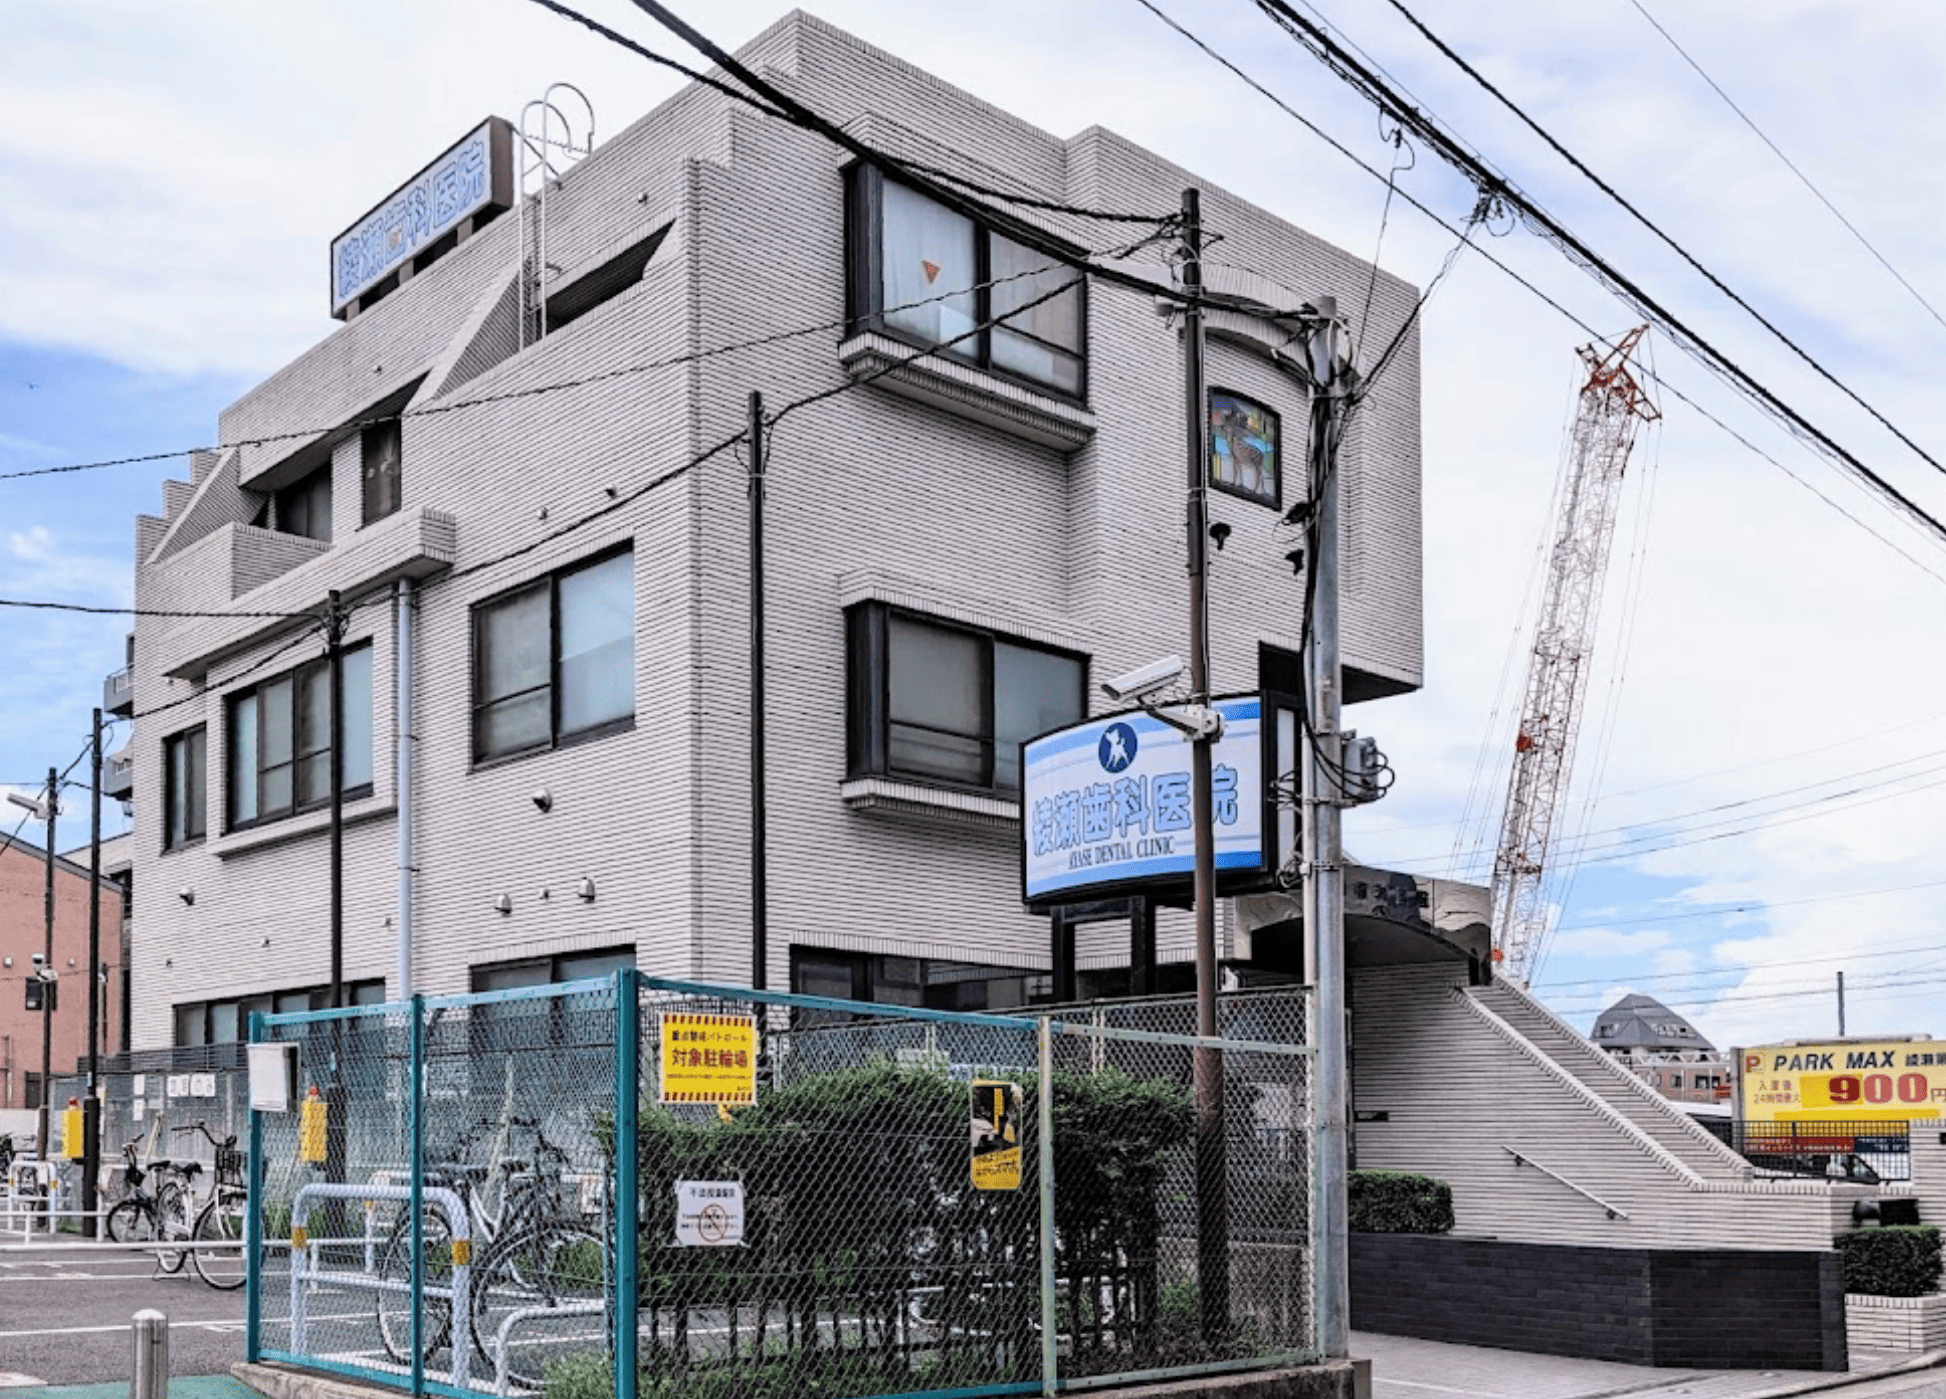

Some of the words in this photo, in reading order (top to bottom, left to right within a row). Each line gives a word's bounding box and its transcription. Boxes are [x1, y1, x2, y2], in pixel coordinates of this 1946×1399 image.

[1095, 841, 1132, 865] DENTAL
[1136, 835, 1175, 859] CLINIC
[672, 1047, 748, 1068] 対象駐輪場
[1773, 1053, 1835, 1071] PARK
[1846, 1050, 1896, 1069] MAX
